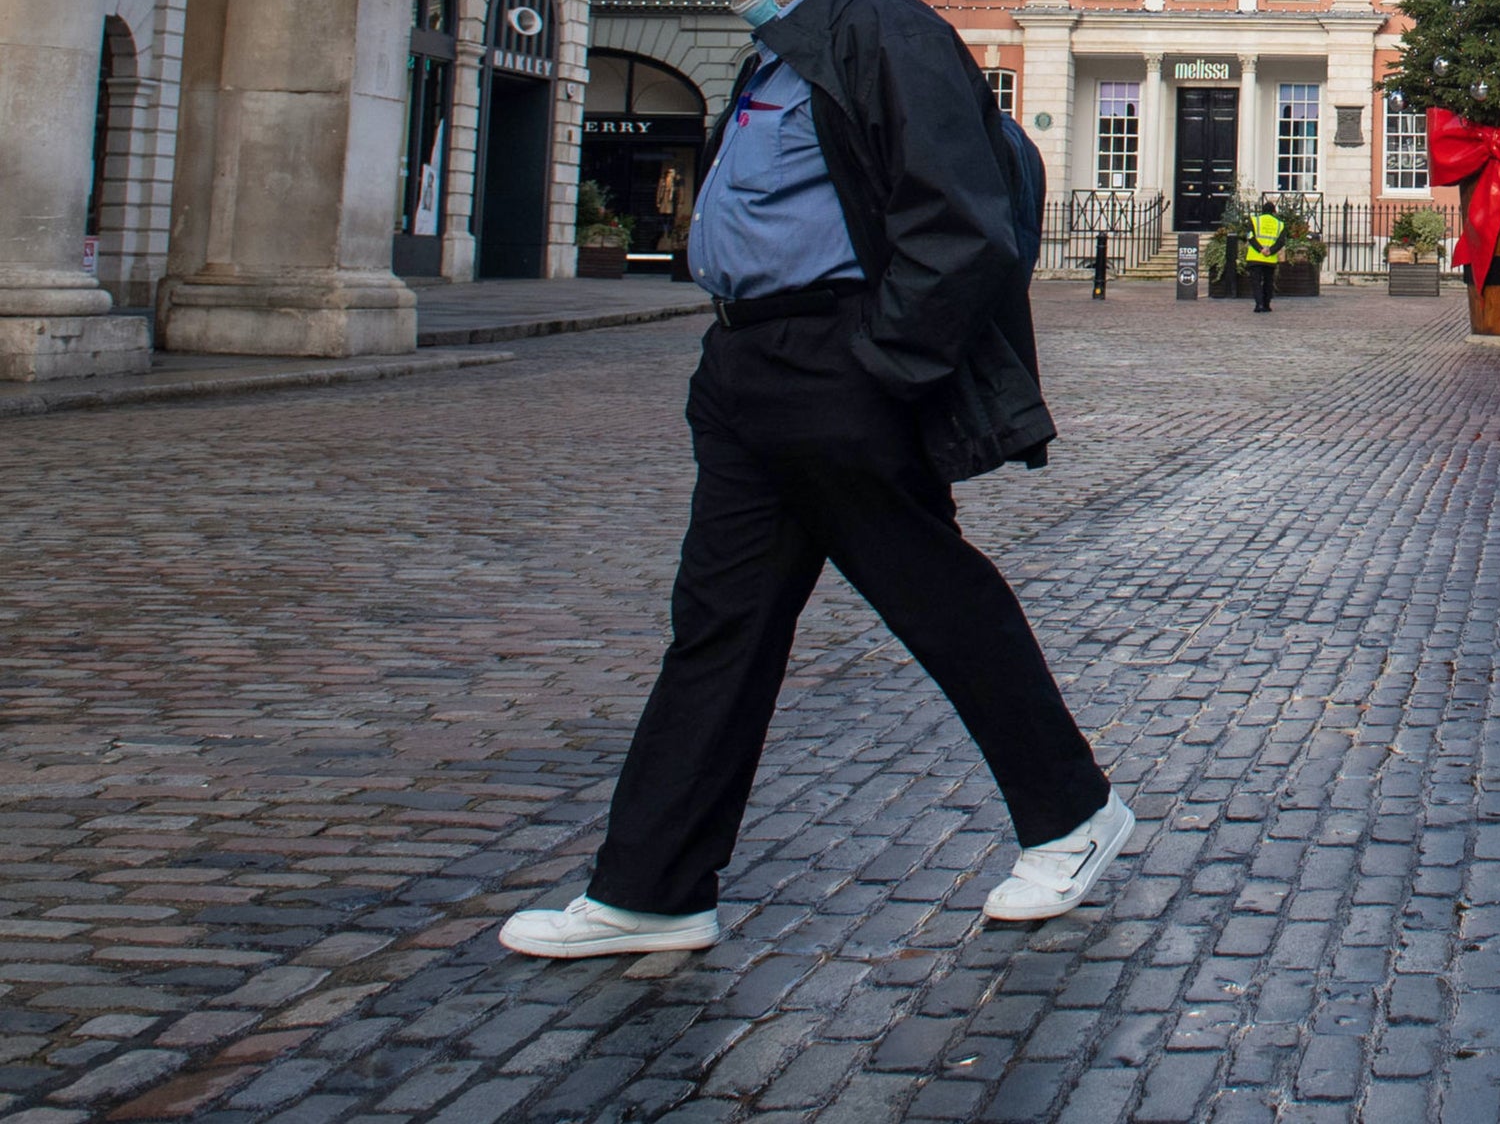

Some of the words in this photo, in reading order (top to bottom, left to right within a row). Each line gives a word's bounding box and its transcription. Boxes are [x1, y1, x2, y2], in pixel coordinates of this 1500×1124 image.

[493, 49, 553, 77] OAKLEY
[1175, 59, 1229, 79] melissa
[1179, 247, 1198, 255] STOP
